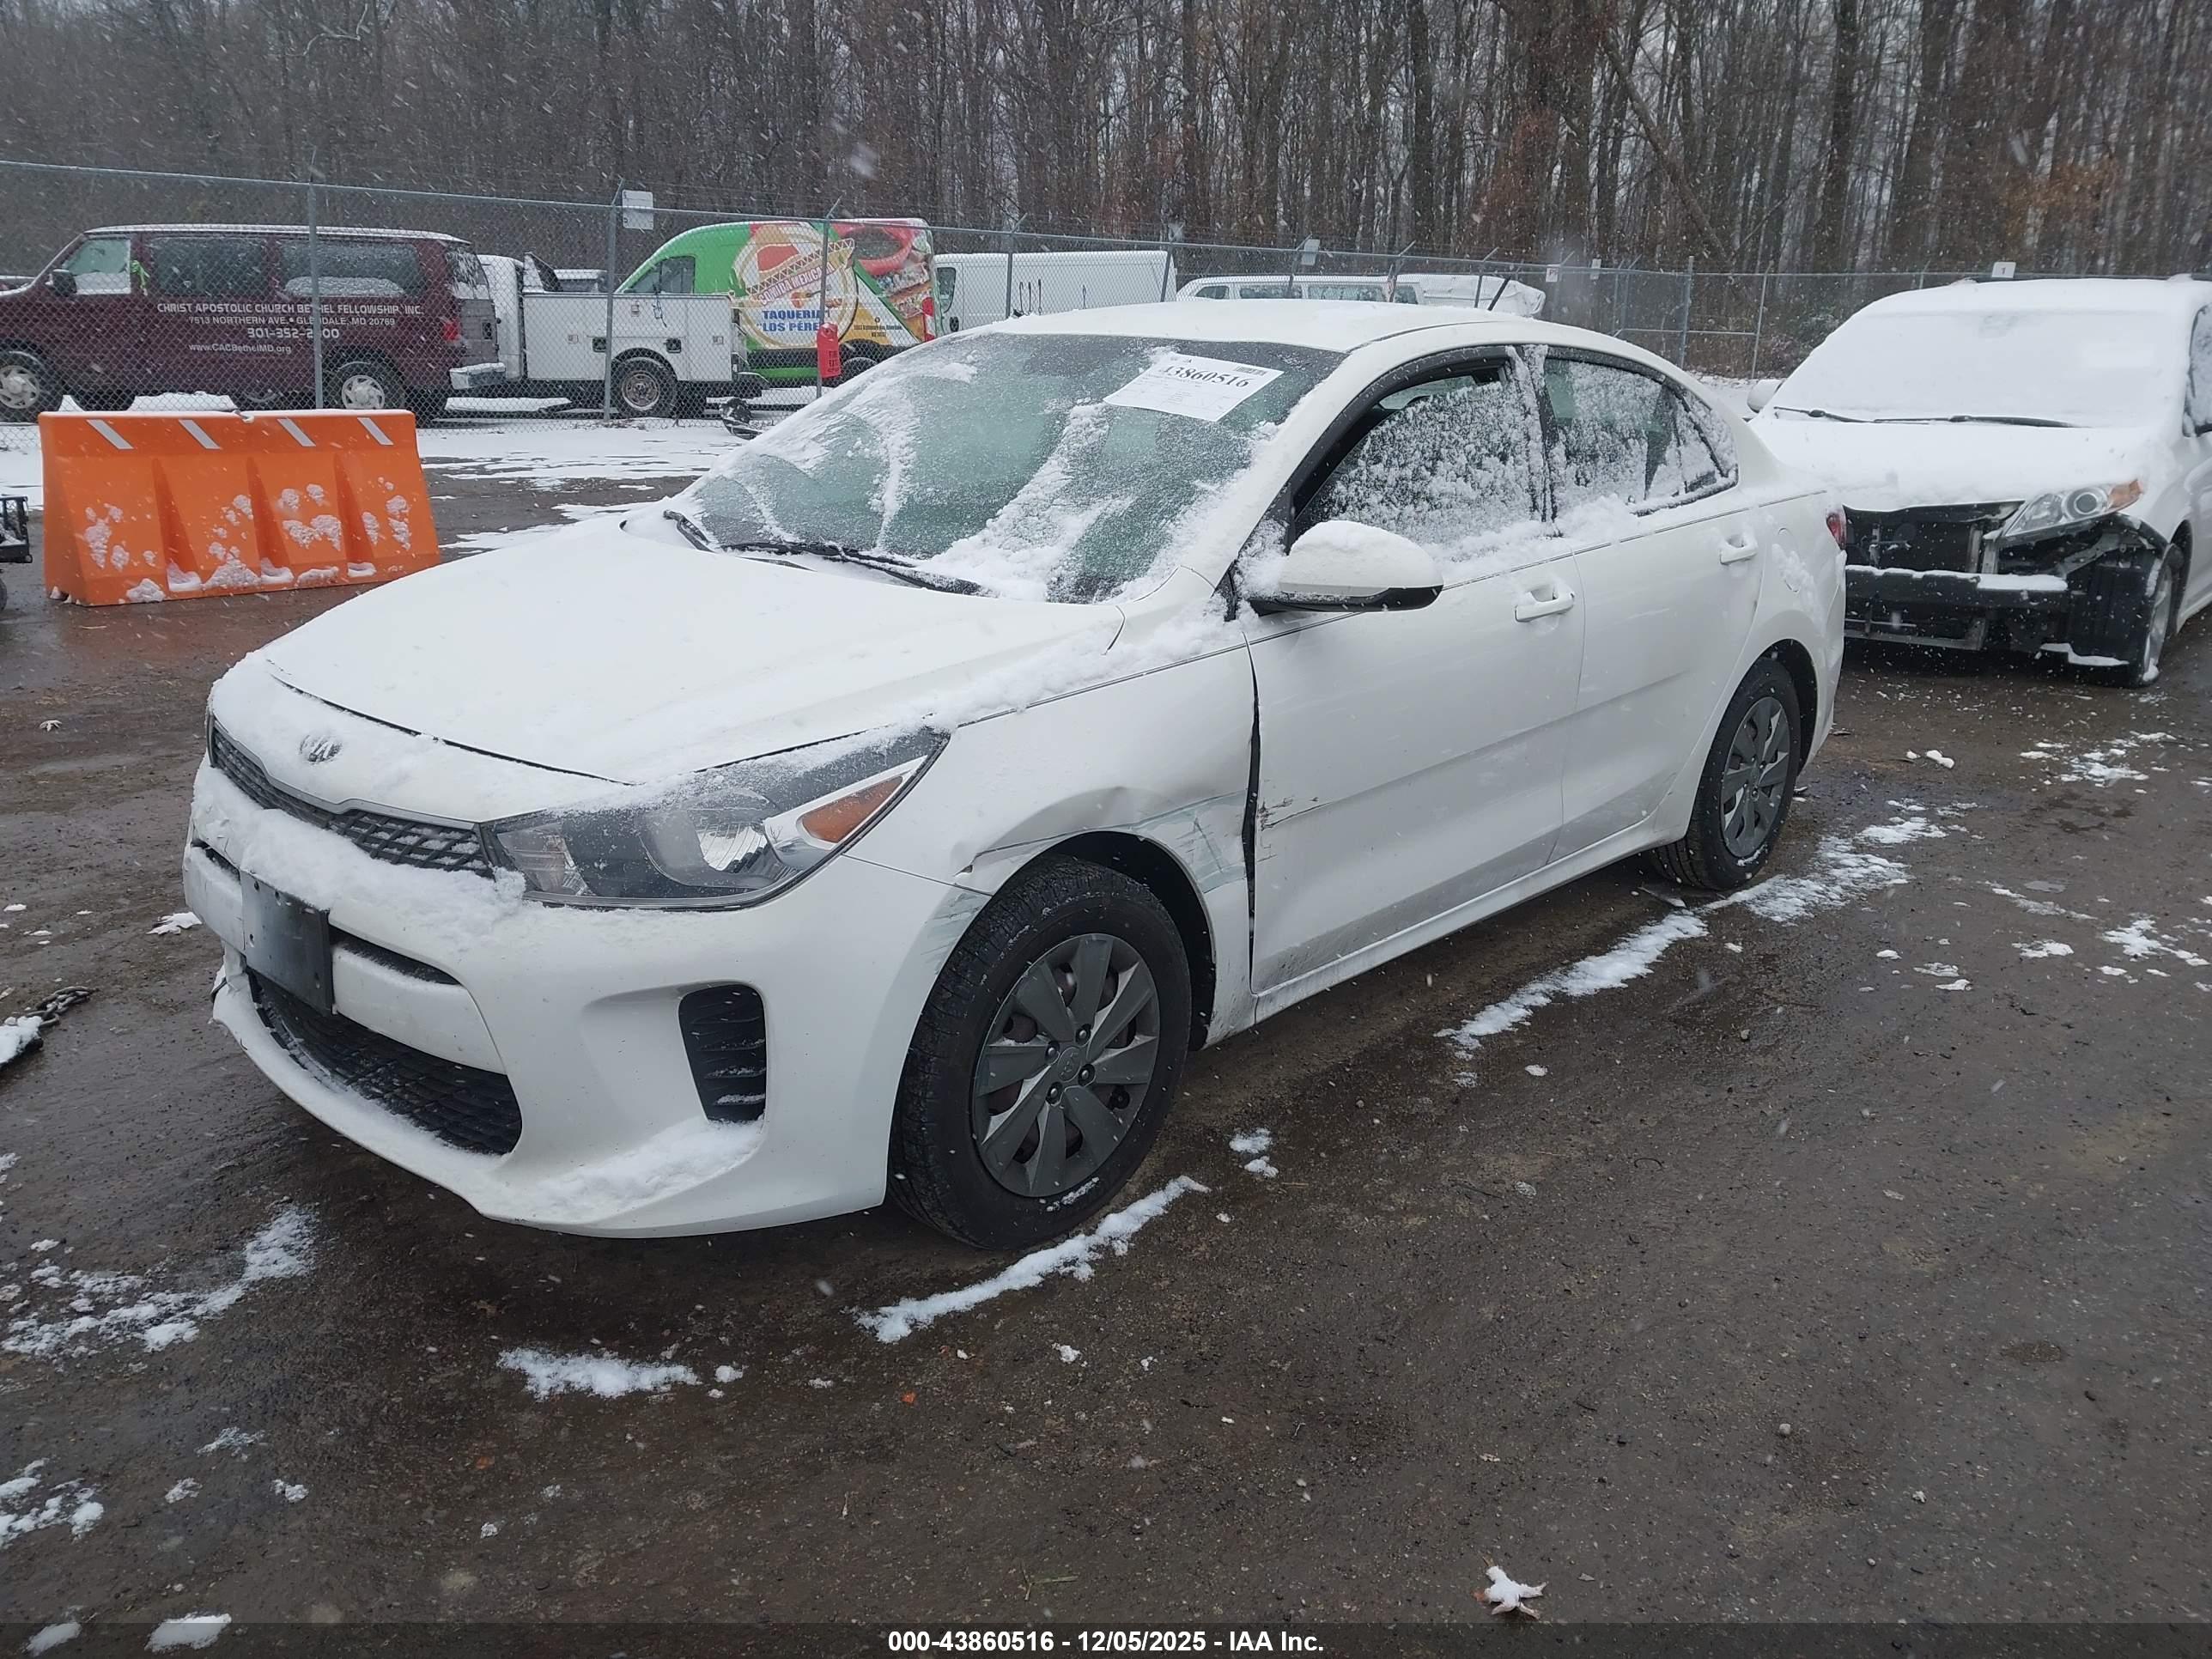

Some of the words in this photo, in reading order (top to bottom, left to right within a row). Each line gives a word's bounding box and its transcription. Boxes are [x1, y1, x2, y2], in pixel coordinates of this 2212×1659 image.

[791, 261, 836, 290] MEXICAA
[157, 303, 192, 313] CHRIST
[195, 303, 252, 313] APOSTOLIC
[254, 303, 295, 313] CHURCH
[296, 304, 334, 313] BEHEL
[296, 317, 349, 325] GLEDALE,
[247, 328, 340, 338] 301-352-200
